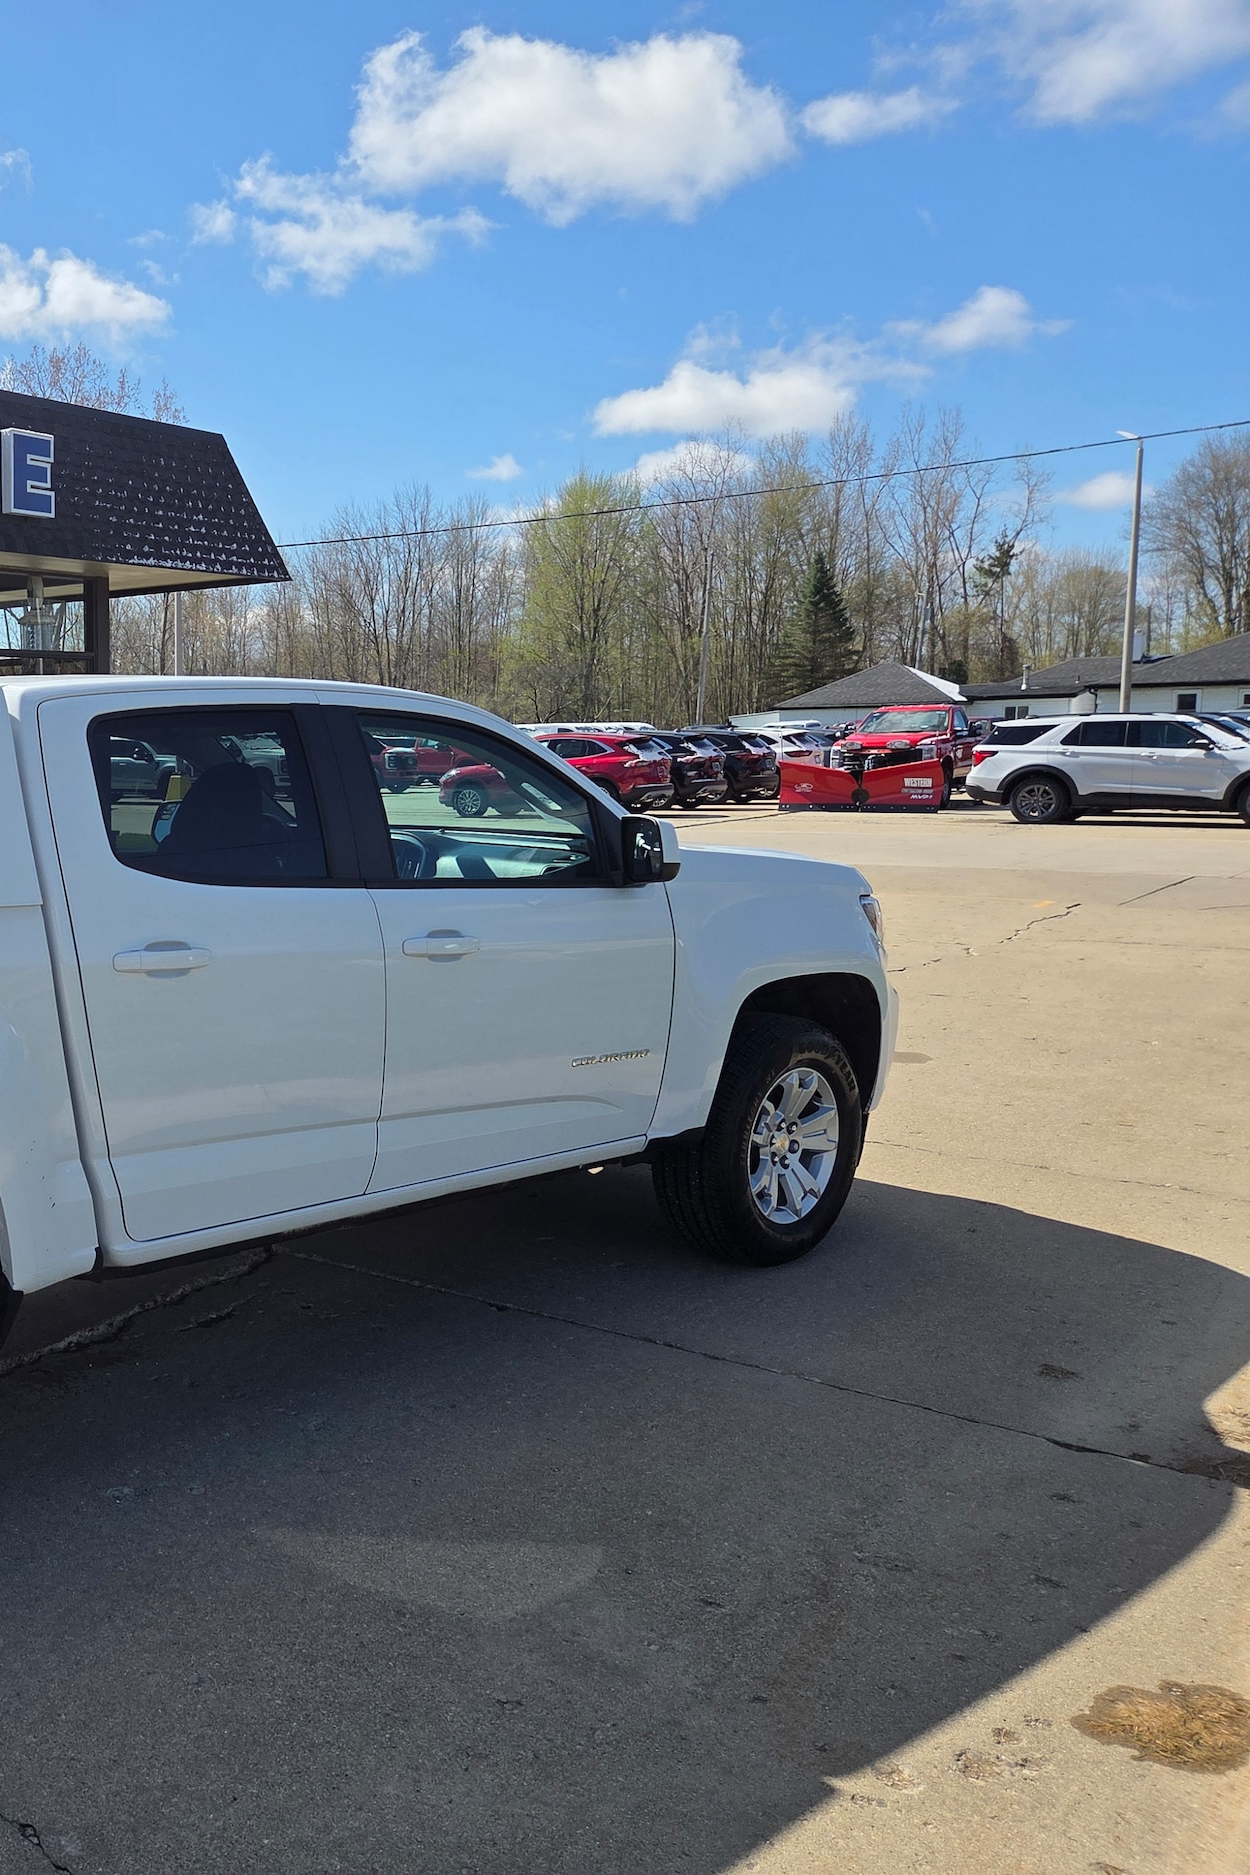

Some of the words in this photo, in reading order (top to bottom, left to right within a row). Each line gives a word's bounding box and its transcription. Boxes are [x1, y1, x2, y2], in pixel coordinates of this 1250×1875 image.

[903, 777, 932, 787] WESTERN
[571, 1048, 650, 1068] COLORADO
[798, 1040, 857, 1093] GOODYEAR
